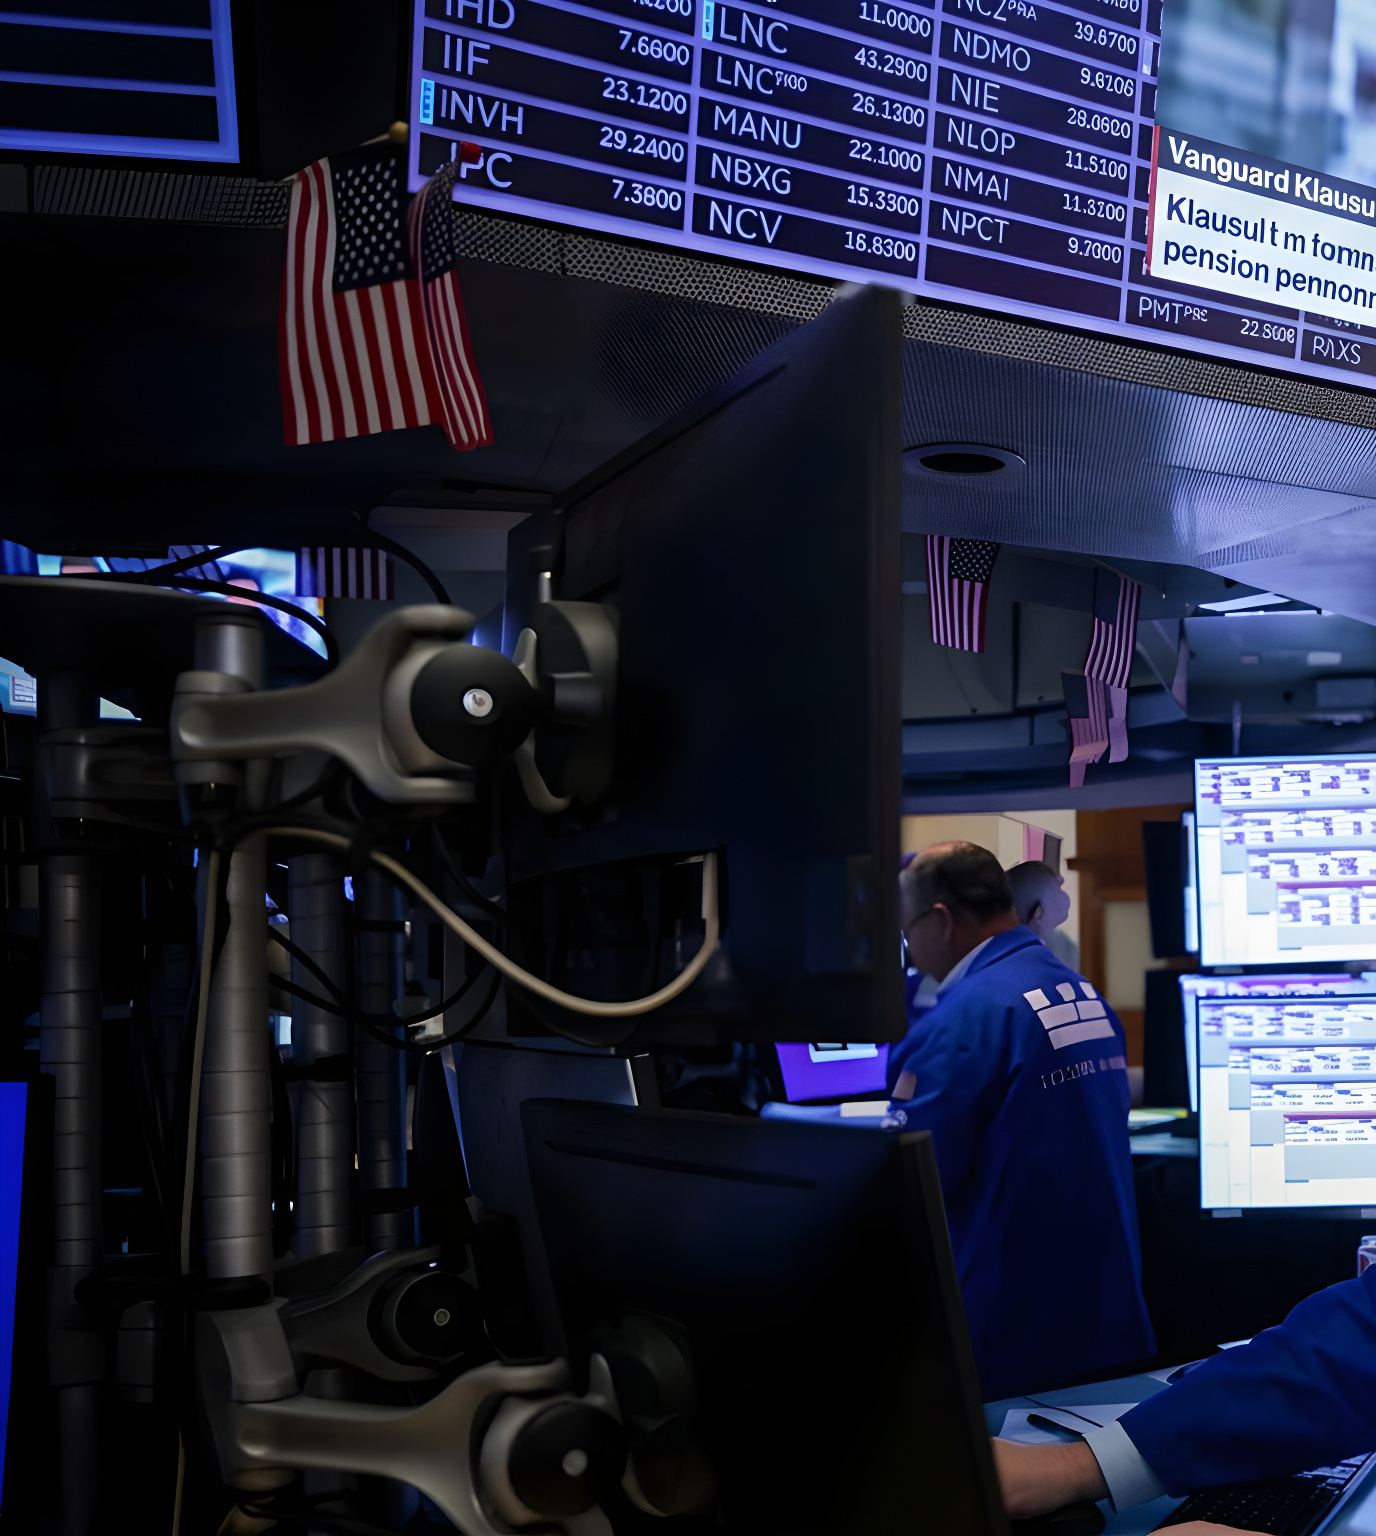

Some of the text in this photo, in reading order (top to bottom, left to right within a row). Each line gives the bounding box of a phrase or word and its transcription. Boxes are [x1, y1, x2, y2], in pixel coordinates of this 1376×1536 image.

[858, 1, 931, 38] 11.0000
[719, 6, 928, 83] LNC 43.2900
[953, 27, 1031, 72] NDMO
[443, 34, 688, 115] IIF 23.1200
[951, 72, 1001, 114] NIE
[440, 88, 685, 163] INVH 29.2400
[852, 92, 925, 129] 26.1300
[714, 104, 922, 173] MANU 22.1000
[947, 117, 1016, 156] NLOP
[710, 152, 919, 217] NBXG 15.3300
[944, 162, 1009, 201] NMAI
[1167, 135, 1291, 195] Vanguard
[709, 200, 783, 244] NCV
[942, 207, 1010, 244] NPCT
[1163, 239, 1270, 283] pension
